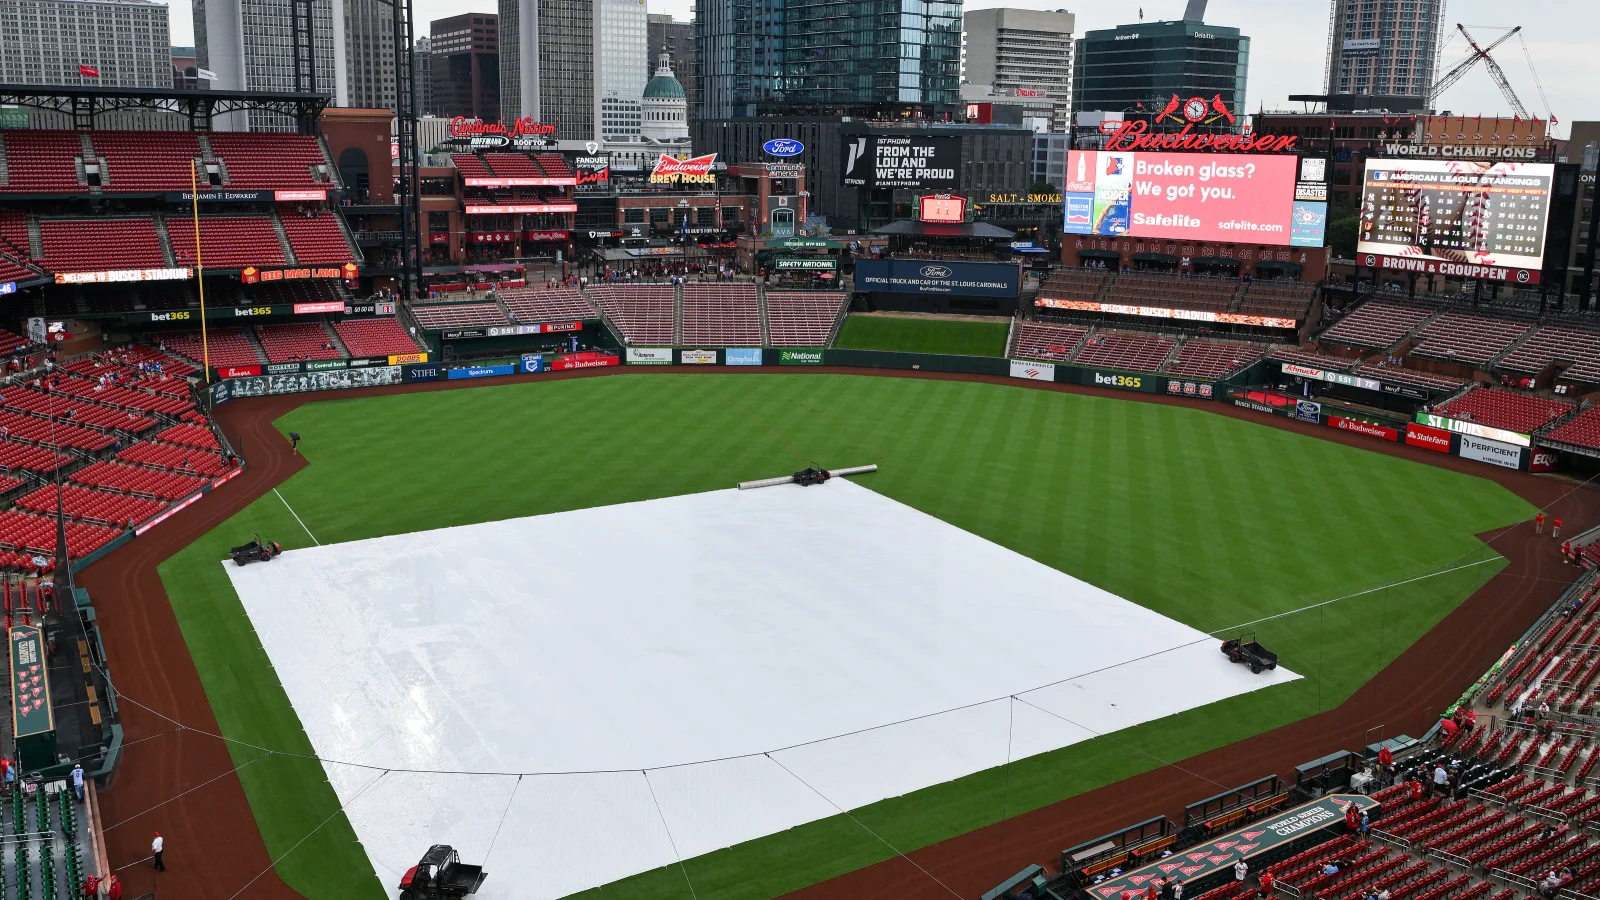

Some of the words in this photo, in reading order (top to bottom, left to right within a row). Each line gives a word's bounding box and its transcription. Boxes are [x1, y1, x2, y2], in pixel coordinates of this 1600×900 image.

[1016, 88, 1036, 97] DRURY
[451, 116, 507, 137] Cardinals
[508, 117, 555, 137] Nation
[1098, 119, 1298, 151] Budweiser
[471, 137, 503, 146] HOFFMANN
[772, 140, 796, 154] Ford
[876, 146, 911, 157] FROM
[912, 146, 935, 157] THE
[1386, 144, 1438, 156] WORLD
[1441, 145, 1536, 158] CHAMPIONS
[656, 160, 716, 173] Budweiser
[765, 163, 803, 173] Community
[876, 157, 898, 168] LOU
[901, 158, 926, 168] AND
[576, 167, 608, 185] Live!
[876, 168, 912, 179] WE'RE
[916, 169, 954, 179] PROUD
[1136, 160, 1194, 177] Broken
[1199, 161, 1256, 182] glass?
[650, 173, 679, 184] BREW
[681, 173, 716, 184] HOUSE
[1390, 172, 1438, 182] AMERICAN
[1440, 174, 1478, 184] LEAGUE
[1481, 176, 1541, 186] STANDINGS
[1067, 181, 1093, 191] Coca-Cola
[1135, 181, 1162, 195] We
[1166, 183, 1195, 201] got
[1200, 187, 1236, 203] you.
[182, 189, 217, 200] BENJAMIN
[218, 189, 224, 199] F.
[990, 193, 1018, 203] SALT
[1027, 193, 1062, 203] SMOKE
[1097, 190, 1128, 200] INSIDER
[1296, 189, 1327, 197] DISASTER
[1133, 212, 1201, 228] Safelite
[1218, 219, 1283, 232] safelite.com
[1135, 242, 1145, 253] 10
[1166, 244, 1176, 255] 17
[1219, 247, 1232, 258] 24
[1238, 249, 1252, 260] 42
[1258, 250, 1272, 261] 45
[261, 271, 283, 281] BIG
[284, 269, 310, 279] MAC
[312, 268, 341, 278] LAND
[925, 266, 946, 277] Ford
[1383, 257, 1425, 272] BROWN
[1428, 264, 1436, 273] &
[1439, 263, 1507, 280] CROUPPEN
[63, 272, 98, 283] WELCOME
[109, 271, 142, 281] BUSCH
[146, 269, 187, 280] STADIUM
[976, 281, 1007, 289] CARDINALS
[235, 307, 272, 317] bet365
[299, 304, 340, 312] cardinals.com
[1100, 303, 1130, 314] WELCOME
[1140, 306, 1170, 318] BUSCH
[1174, 308, 1215, 322] STADIUM
[151, 312, 190, 321] bet365
[574, 360, 608, 369] Budweiser
[1285, 364, 1320, 376] Schnucks
[411, 368, 438, 378] STIFEL
[468, 368, 492, 376] Spectrum
[1095, 372, 1141, 388] bet365
[1338, 375, 1351, 384] 5:51
[1235, 399, 1251, 408] BUSCH
[1251, 403, 1273, 413] STADIUM
[1301, 403, 1315, 412] Ford
[1349, 421, 1386, 437] Budweiser
[1428, 414, 1445, 429] ST.
[1447, 418, 1483, 437] LOUIS
[1471, 442, 1519, 458] PERFICIENT
[1267, 816, 1298, 831] WORLD
[1296, 806, 1325, 820] SERIES
[1276, 810, 1335, 836] CHAMPIONS
